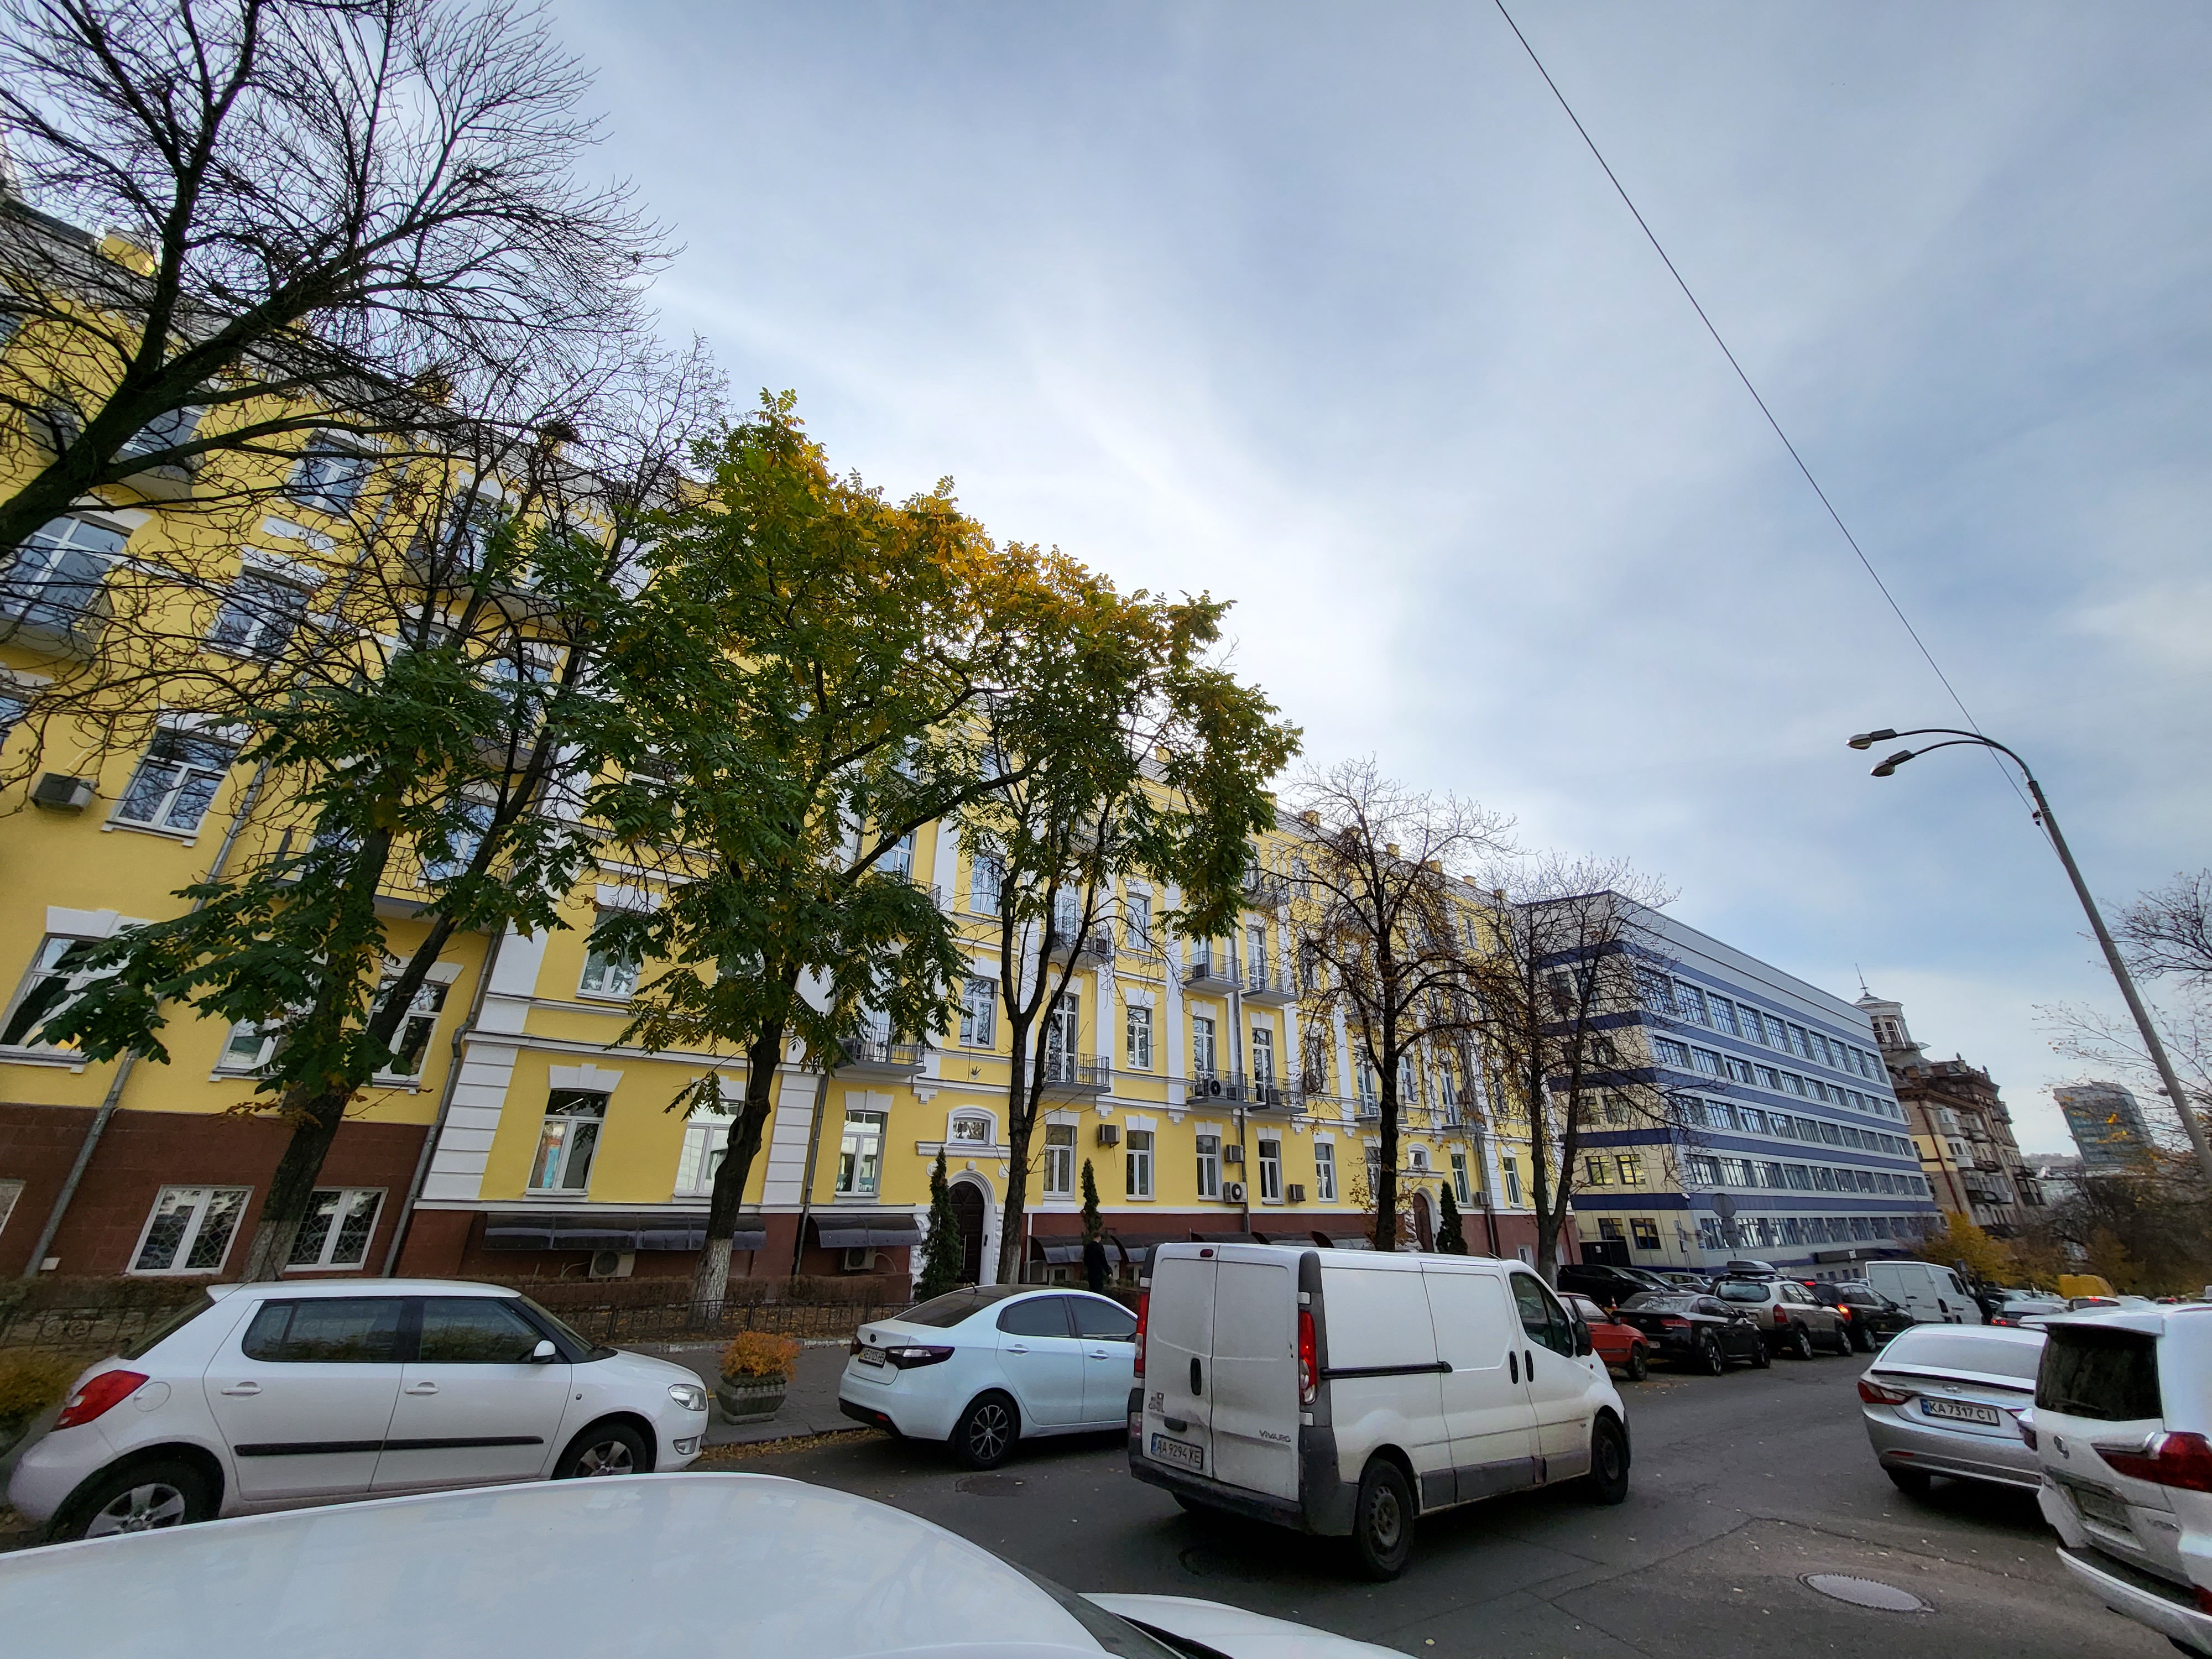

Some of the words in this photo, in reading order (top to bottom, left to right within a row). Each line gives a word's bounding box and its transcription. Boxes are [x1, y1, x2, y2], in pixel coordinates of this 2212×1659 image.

[1929, 1402, 1946, 1414] KA
[1948, 1405, 1973, 1417] 7317
[1977, 1410, 1992, 1421] CI
[1156, 1439, 1167, 1454] AA
[1169, 1443, 1187, 1459] 9294
